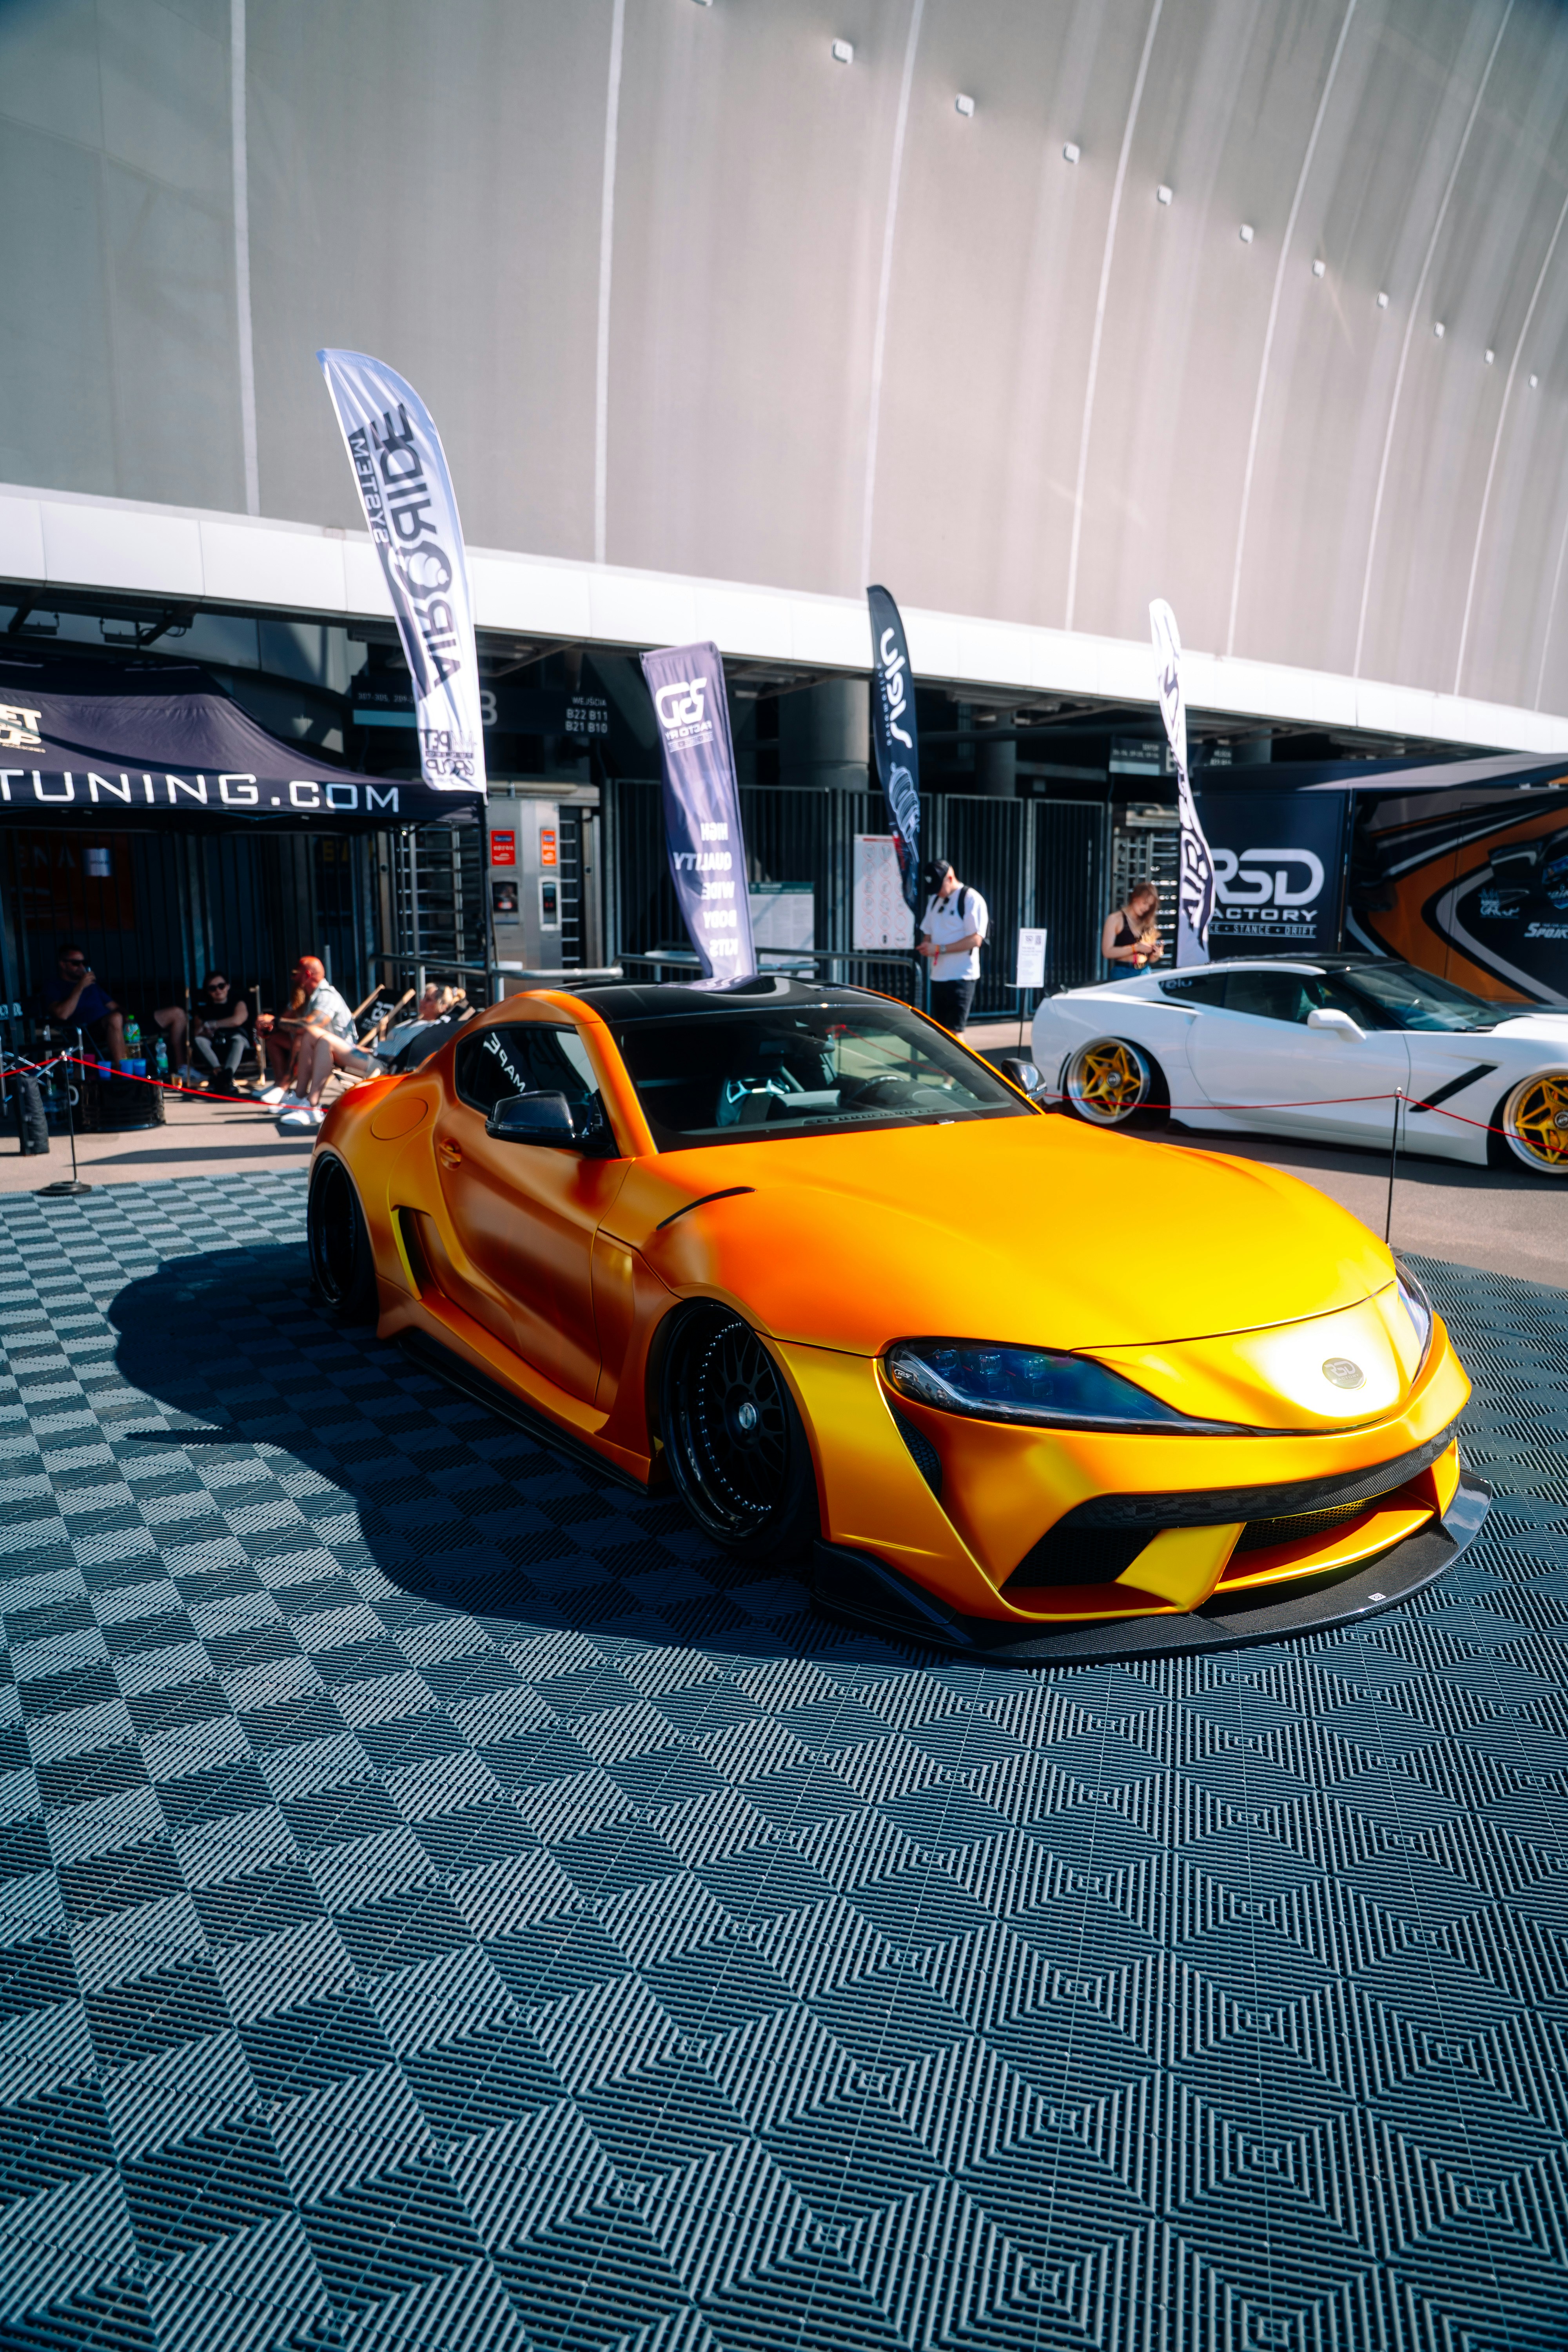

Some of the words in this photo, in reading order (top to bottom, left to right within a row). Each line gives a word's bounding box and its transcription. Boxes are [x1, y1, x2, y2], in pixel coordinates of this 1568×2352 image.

[566, 708, 586, 720] B22
[588, 710, 608, 721] B11
[565, 720, 584, 731] B21
[588, 722, 607, 733] B10
[0, 769, 399, 813] TUNING.COM
[1210, 848, 1325, 906] RSD
[1214, 907, 1318, 921] ACTORY
[1233, 925, 1270, 935] STANCE
[1285, 926, 1314, 936] DRIFT
[1324, 1361, 1356, 1377] RSD
